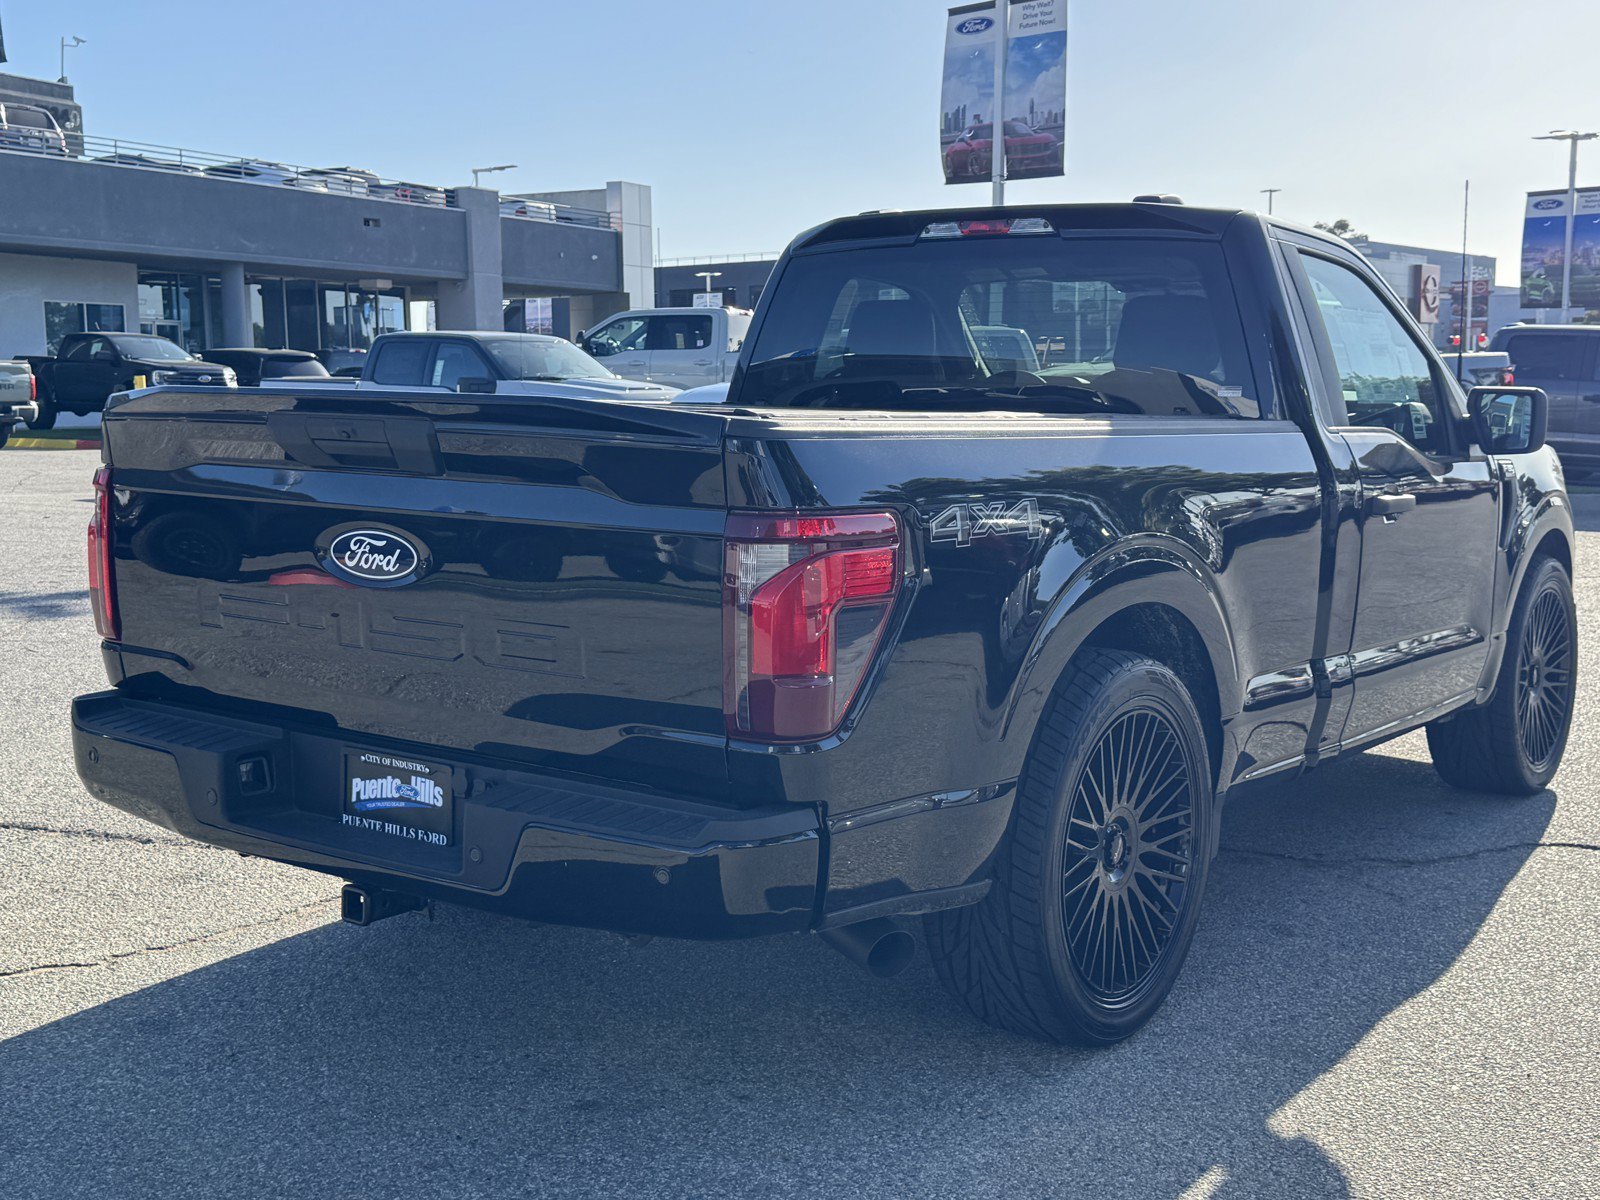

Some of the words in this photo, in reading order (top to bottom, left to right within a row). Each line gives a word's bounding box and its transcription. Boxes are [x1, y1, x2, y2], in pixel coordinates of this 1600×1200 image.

[1022, 3, 1036, 11] Why
[962, 19, 988, 33] Ford
[345, 536, 401, 572] Ford
[365, 753, 380, 764] CITY
[381, 757, 391, 766] OF
[392, 758, 426, 772] INDUSTRY
[351, 775, 402, 803] Puente
[411, 775, 444, 808] Hills
[342, 813, 382, 832] PUENTE
[384, 822, 415, 839] HILLS
[418, 829, 447, 846] FORD
